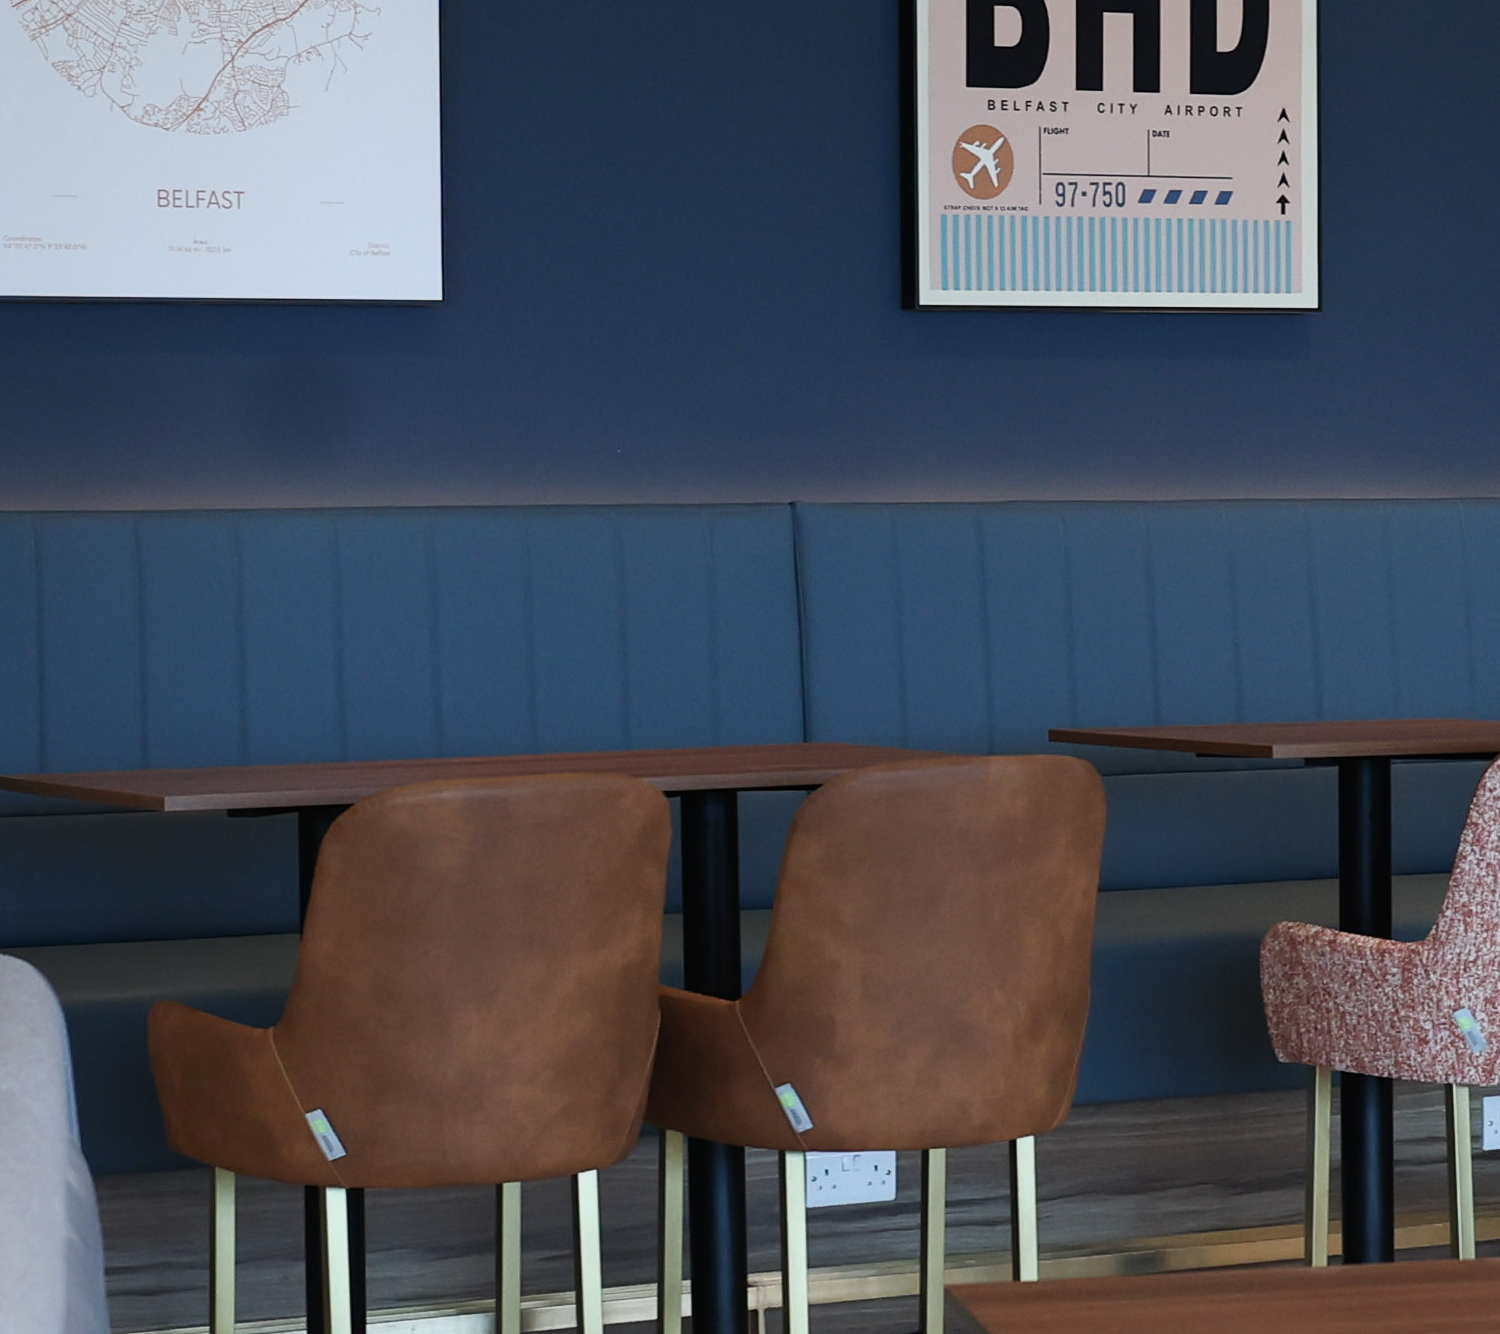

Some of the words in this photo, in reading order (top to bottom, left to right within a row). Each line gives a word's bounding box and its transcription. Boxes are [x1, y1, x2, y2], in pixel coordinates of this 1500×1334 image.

[986, 99, 1070, 113] BELFAST
[1096, 102, 1139, 115] CITY
[1164, 104, 1244, 118] AIRPORT
[1043, 127, 1070, 136] FLIGHT
[1151, 129, 1171, 138] DATE
[156, 189, 245, 210] BELFAST
